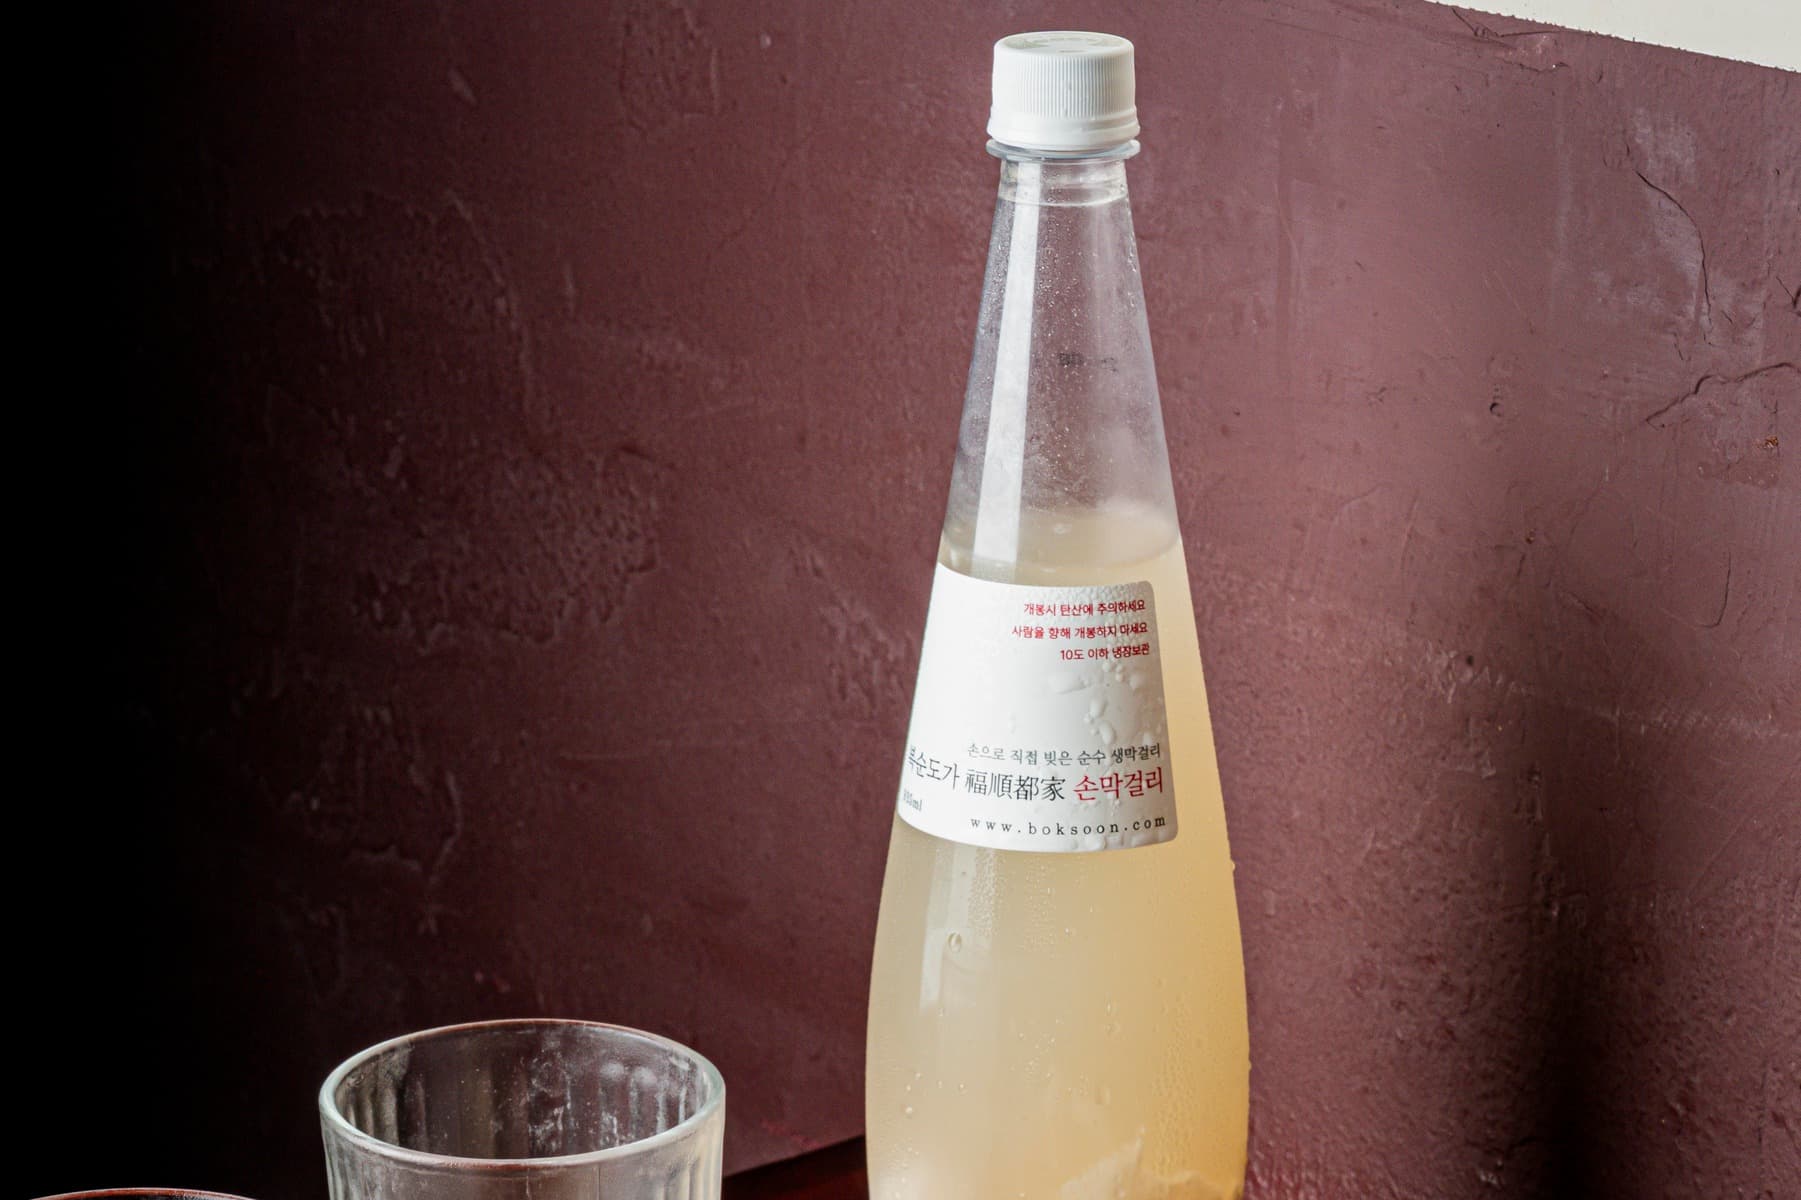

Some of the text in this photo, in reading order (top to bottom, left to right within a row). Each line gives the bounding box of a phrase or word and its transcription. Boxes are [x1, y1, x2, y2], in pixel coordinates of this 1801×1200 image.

[1024, 599, 1146, 617] 개봉시 탄산에 주의하세요
[1012, 622, 1148, 639] 사람을 향해 개봉하지 마세요
[1060, 643, 1150, 661] 10도 이하 냉장보관
[967, 743, 1162, 767] 손으로 직접 빚은 순수 생막걸리
[965, 768, 1066, 801] 福順都家
[1072, 766, 1165, 801] 손막걸리
[970, 815, 1167, 836] www.boksoon.com
